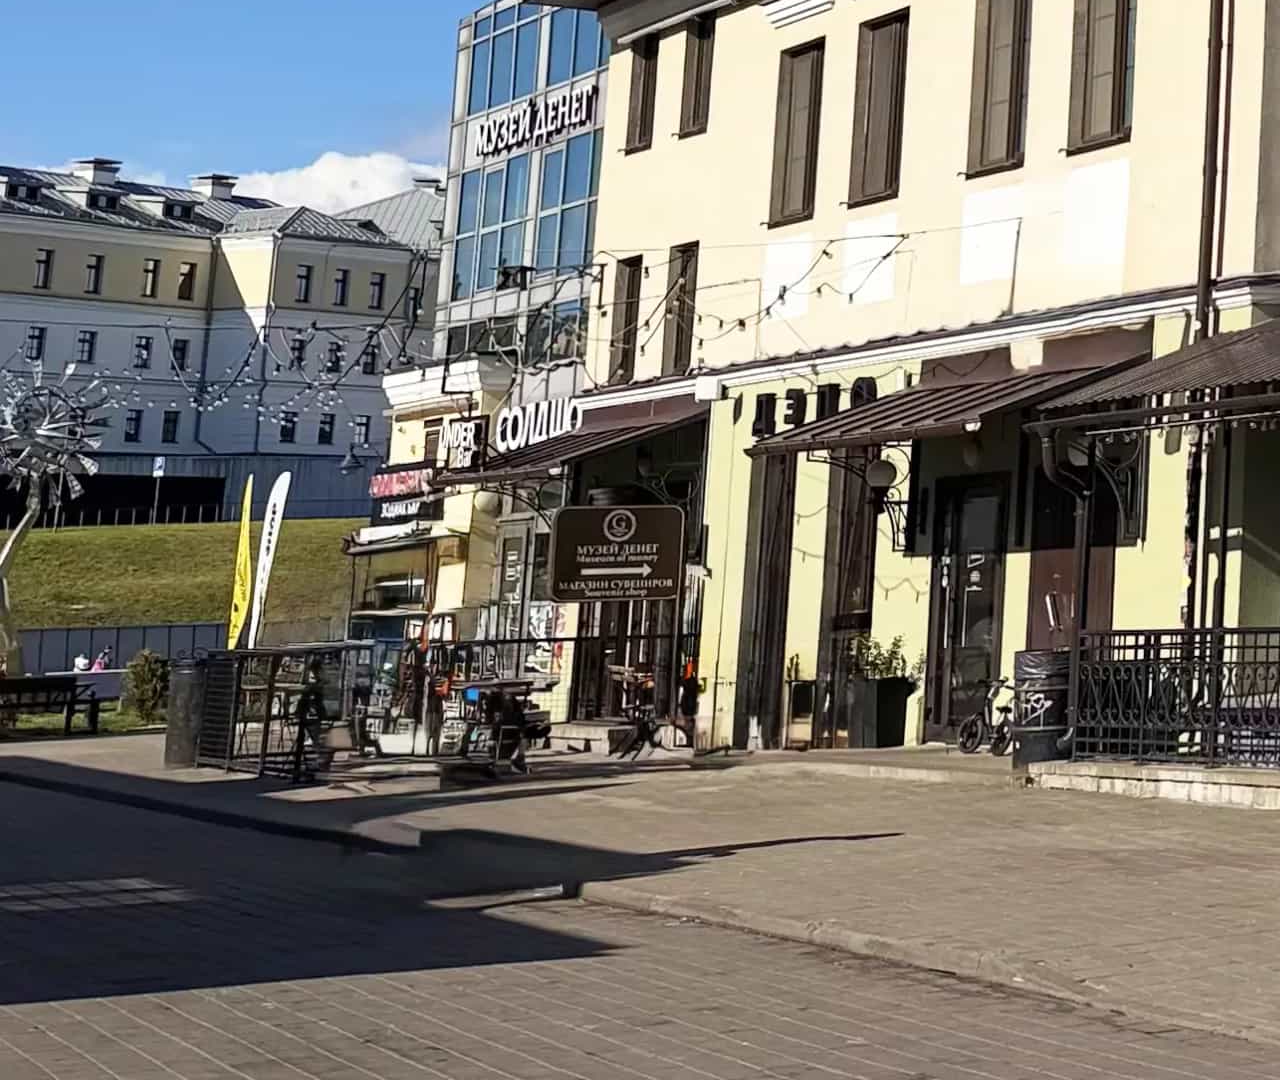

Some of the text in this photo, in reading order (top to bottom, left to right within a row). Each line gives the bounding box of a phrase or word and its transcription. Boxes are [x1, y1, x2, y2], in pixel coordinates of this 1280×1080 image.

[473, 84, 596, 155] МУЗЕЙ ДЕНЕГ
[438, 419, 477, 450] UNDER
[576, 543, 660, 555] МУЗЕЙ ДЕНЕГ
[559, 579, 673, 592] МАГАЗИН СУВЕНИРОВ
